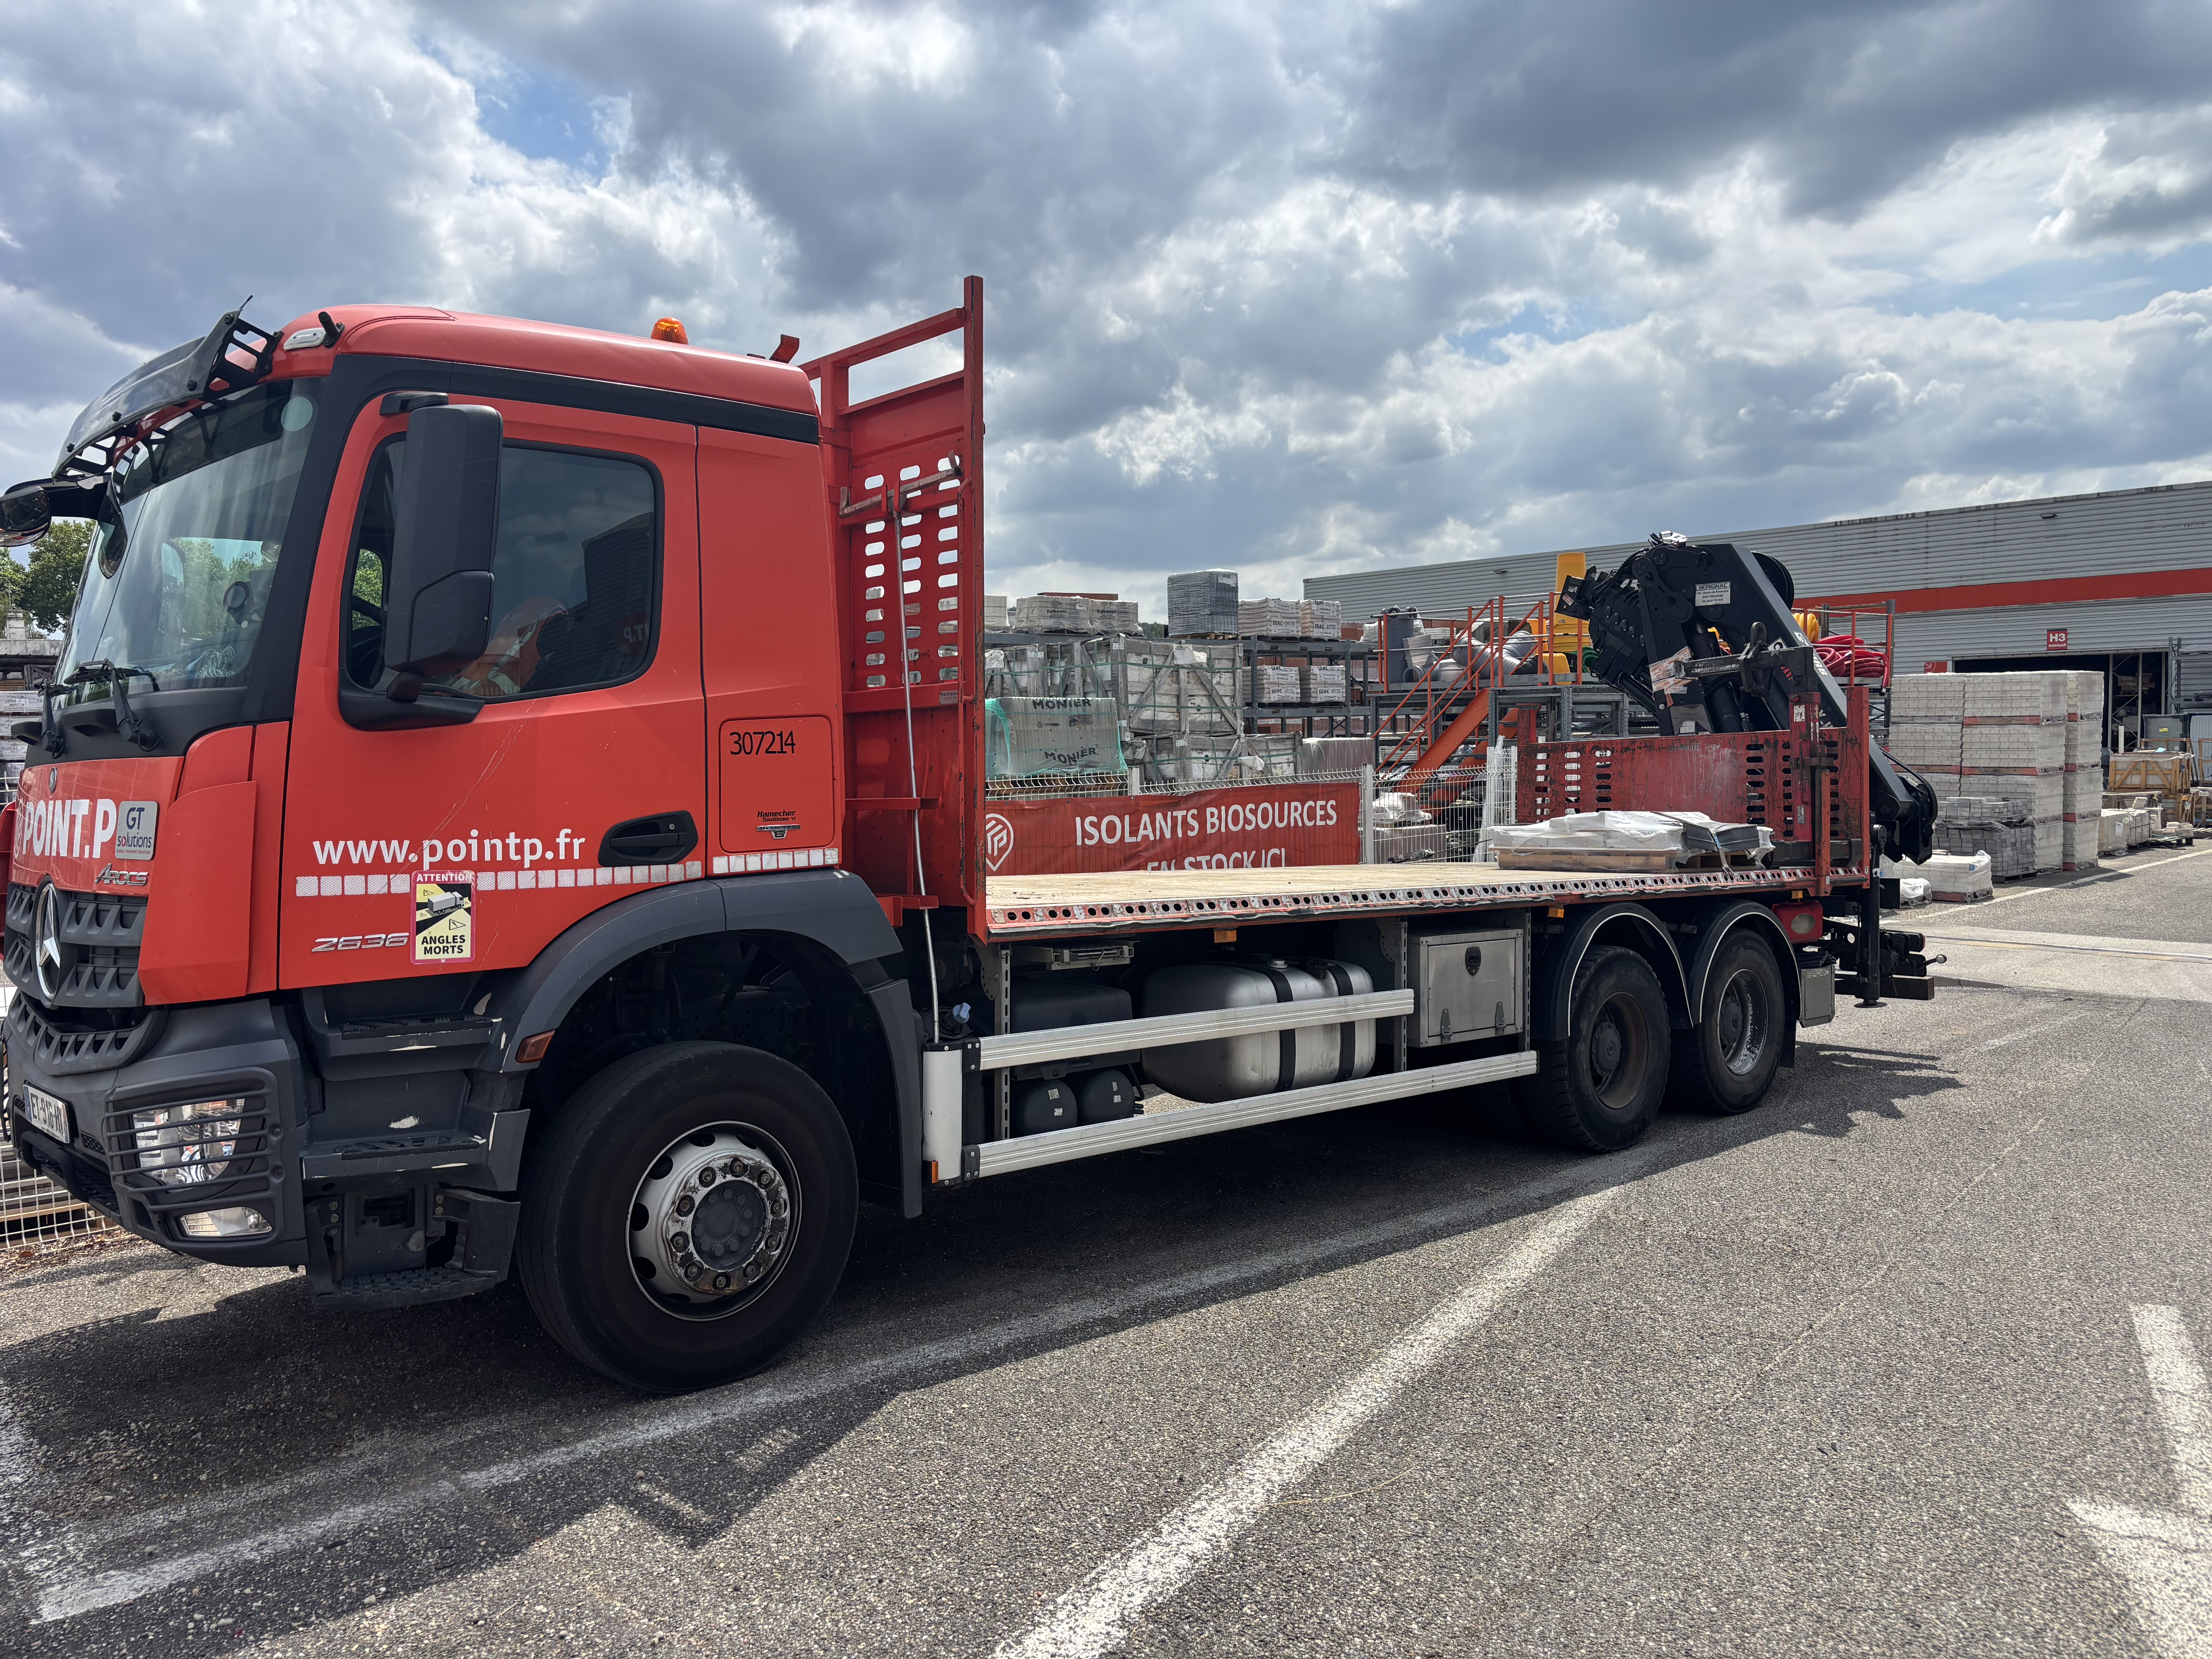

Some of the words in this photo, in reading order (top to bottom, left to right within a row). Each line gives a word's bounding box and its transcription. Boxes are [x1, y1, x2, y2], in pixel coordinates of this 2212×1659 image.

[2050, 633, 2066, 642] H3
[1032, 698, 1092, 709] MONIER
[730, 730, 796, 755] 307214
[1044, 747, 1096, 765] MONIER
[126, 807, 145, 830] GT
[1075, 809, 1199, 846] ISOLANTS
[1206, 800, 1337, 834] BIOSOURCES
[117, 832, 152, 848] solutions
[312, 829, 586, 871] www.pointp.fr
[416, 873, 472, 882] ATTENTION
[311, 932, 409, 953] 2636
[421, 935, 465, 945] ANGLES
[424, 945, 464, 955] MORTS
